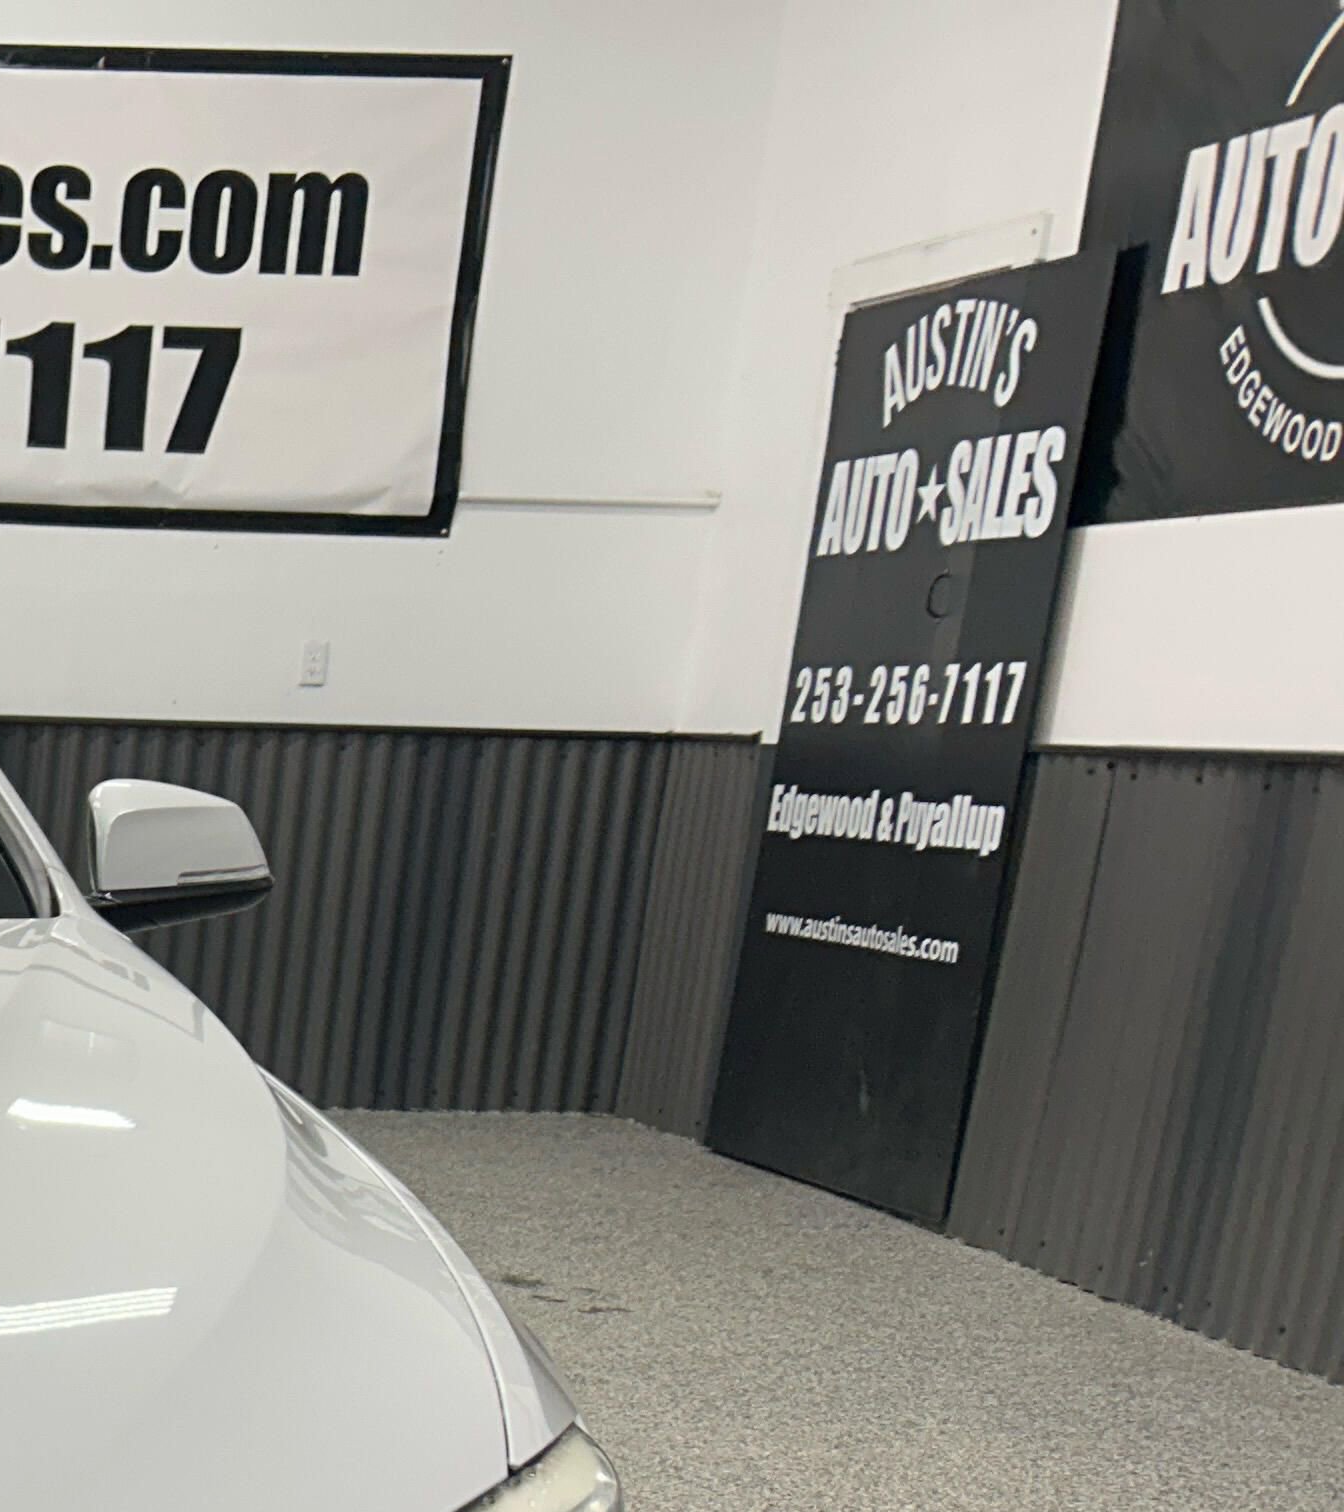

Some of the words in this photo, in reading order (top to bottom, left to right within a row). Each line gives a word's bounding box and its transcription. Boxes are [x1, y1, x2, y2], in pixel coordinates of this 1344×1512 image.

[882, 298, 1038, 428] AUSTIN'S
[1220, 324, 1343, 461] EDGEWOOD
[816, 448, 919, 557] AUTO
[939, 426, 1066, 546] SALES
[790, 661, 1027, 725] 253-256-7117
[767, 784, 881, 839] Edgewood
[876, 798, 894, 843] &
[894, 791, 1006, 856] Puyallup
[765, 912, 959, 963] www.austinsautosales.com
